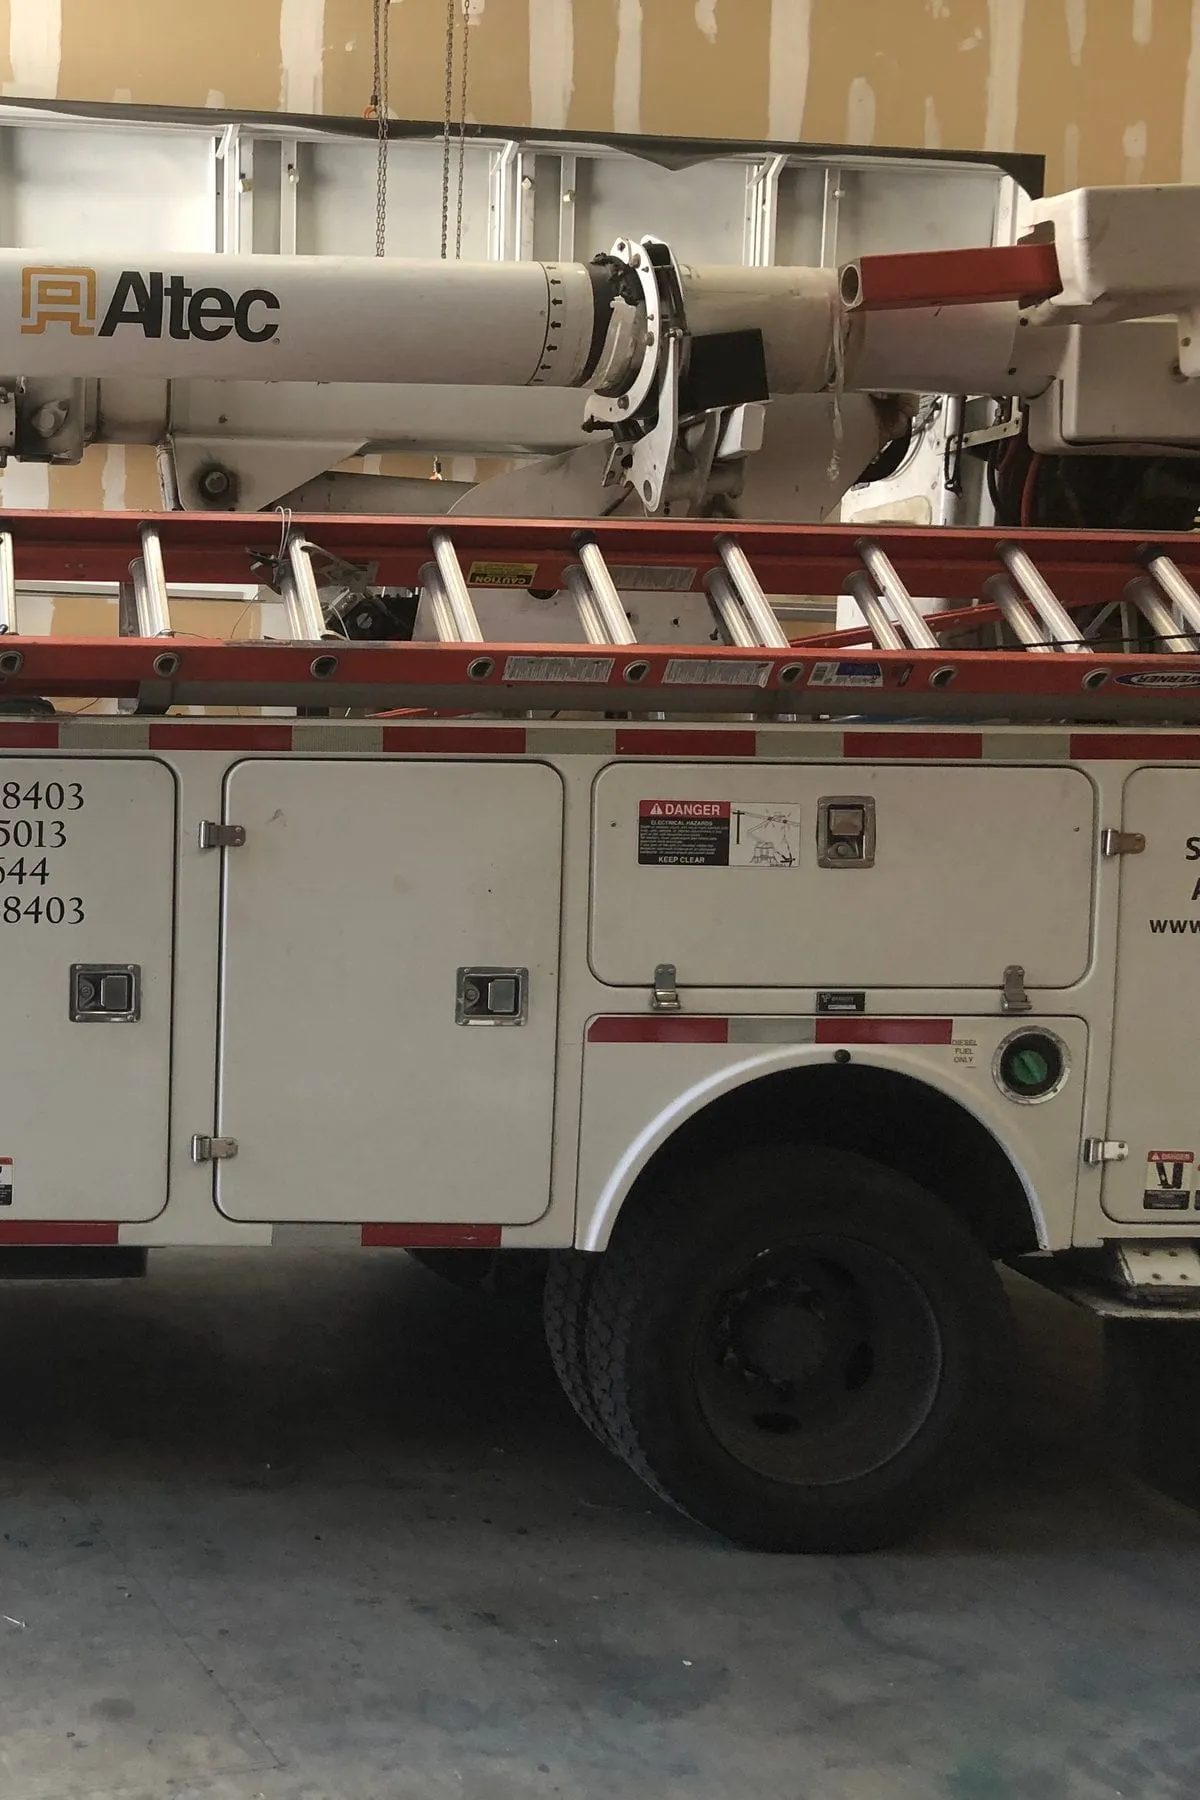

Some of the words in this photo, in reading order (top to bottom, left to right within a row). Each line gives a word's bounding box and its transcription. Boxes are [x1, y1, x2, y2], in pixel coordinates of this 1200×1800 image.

[98, 271, 281, 343] Altec
[665, 803, 720, 816] DANGER
[658, 856, 678, 864] KEEP
[680, 856, 705, 864] CLEAR
